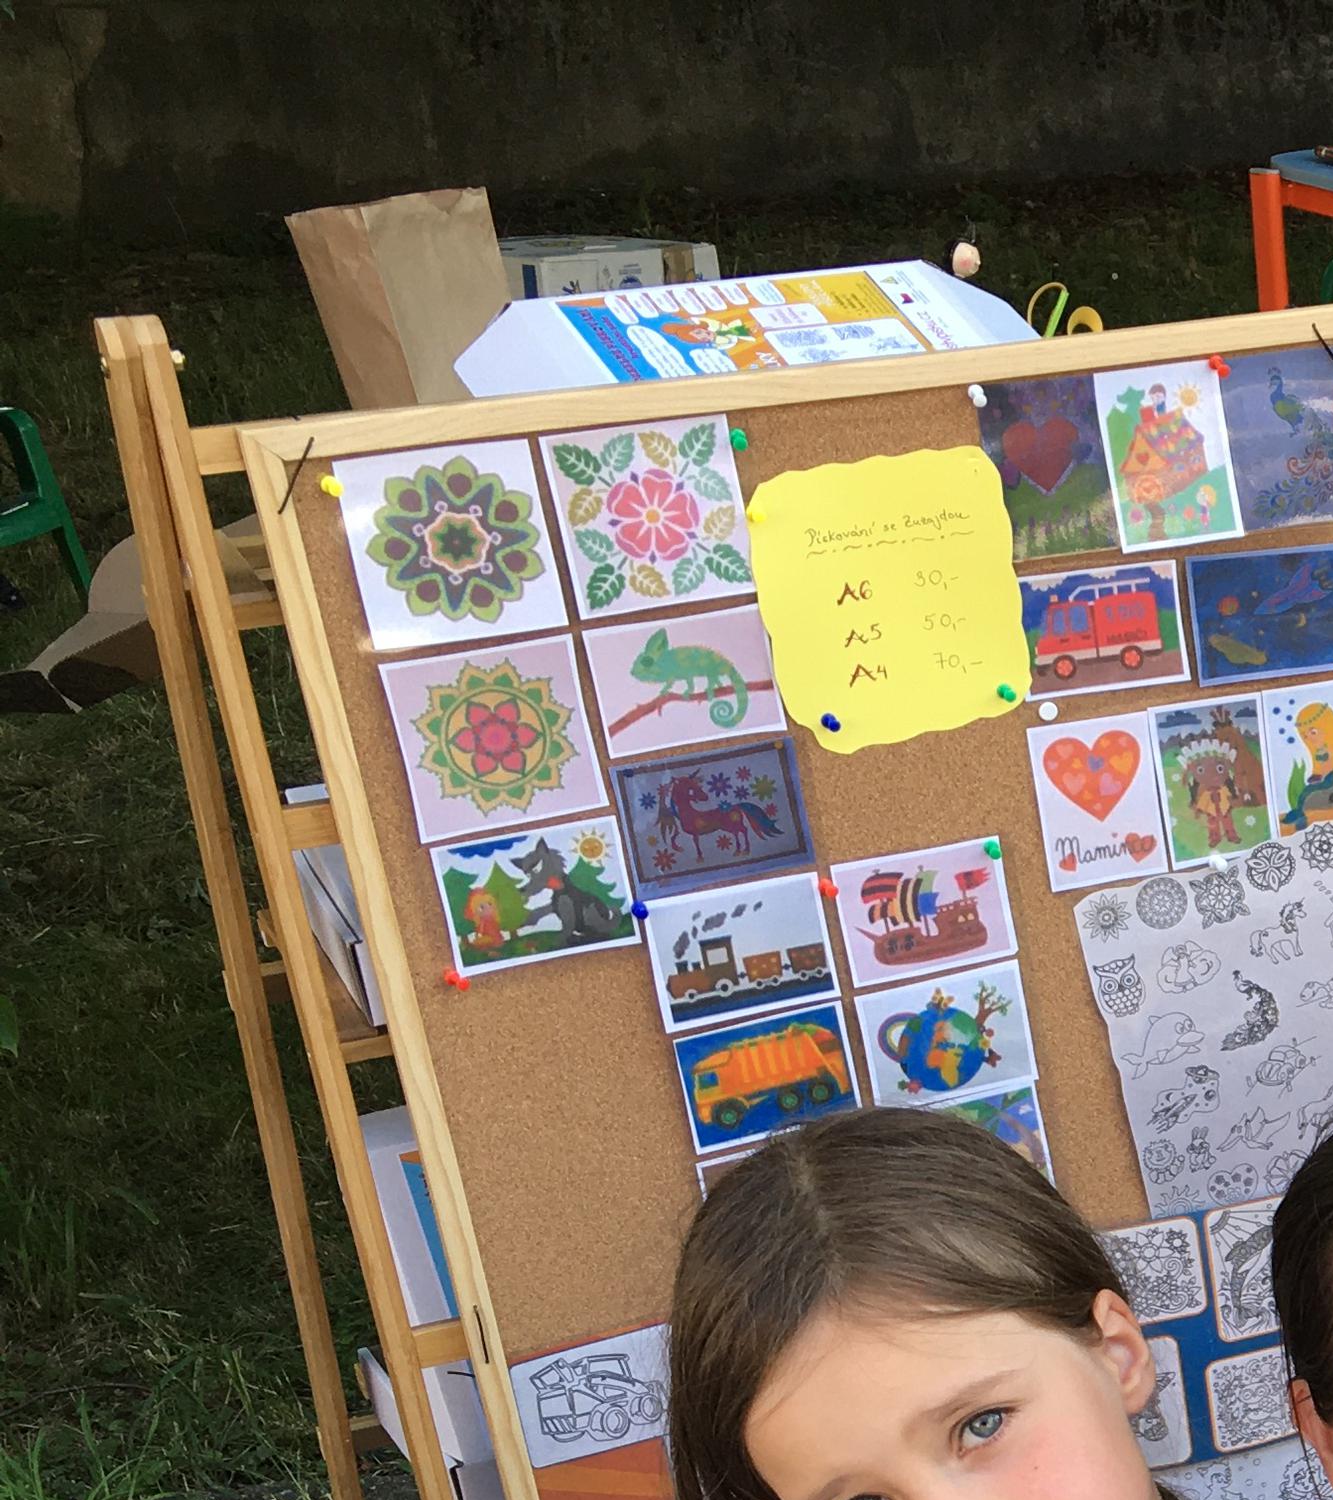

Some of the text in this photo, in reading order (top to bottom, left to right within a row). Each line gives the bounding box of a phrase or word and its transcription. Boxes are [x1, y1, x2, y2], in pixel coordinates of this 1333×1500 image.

[883, 523, 897, 532] se
[837, 580, 873, 606] A6
[844, 613, 966, 648] A5 50,-
[849, 651, 983, 688] A4 70,-
